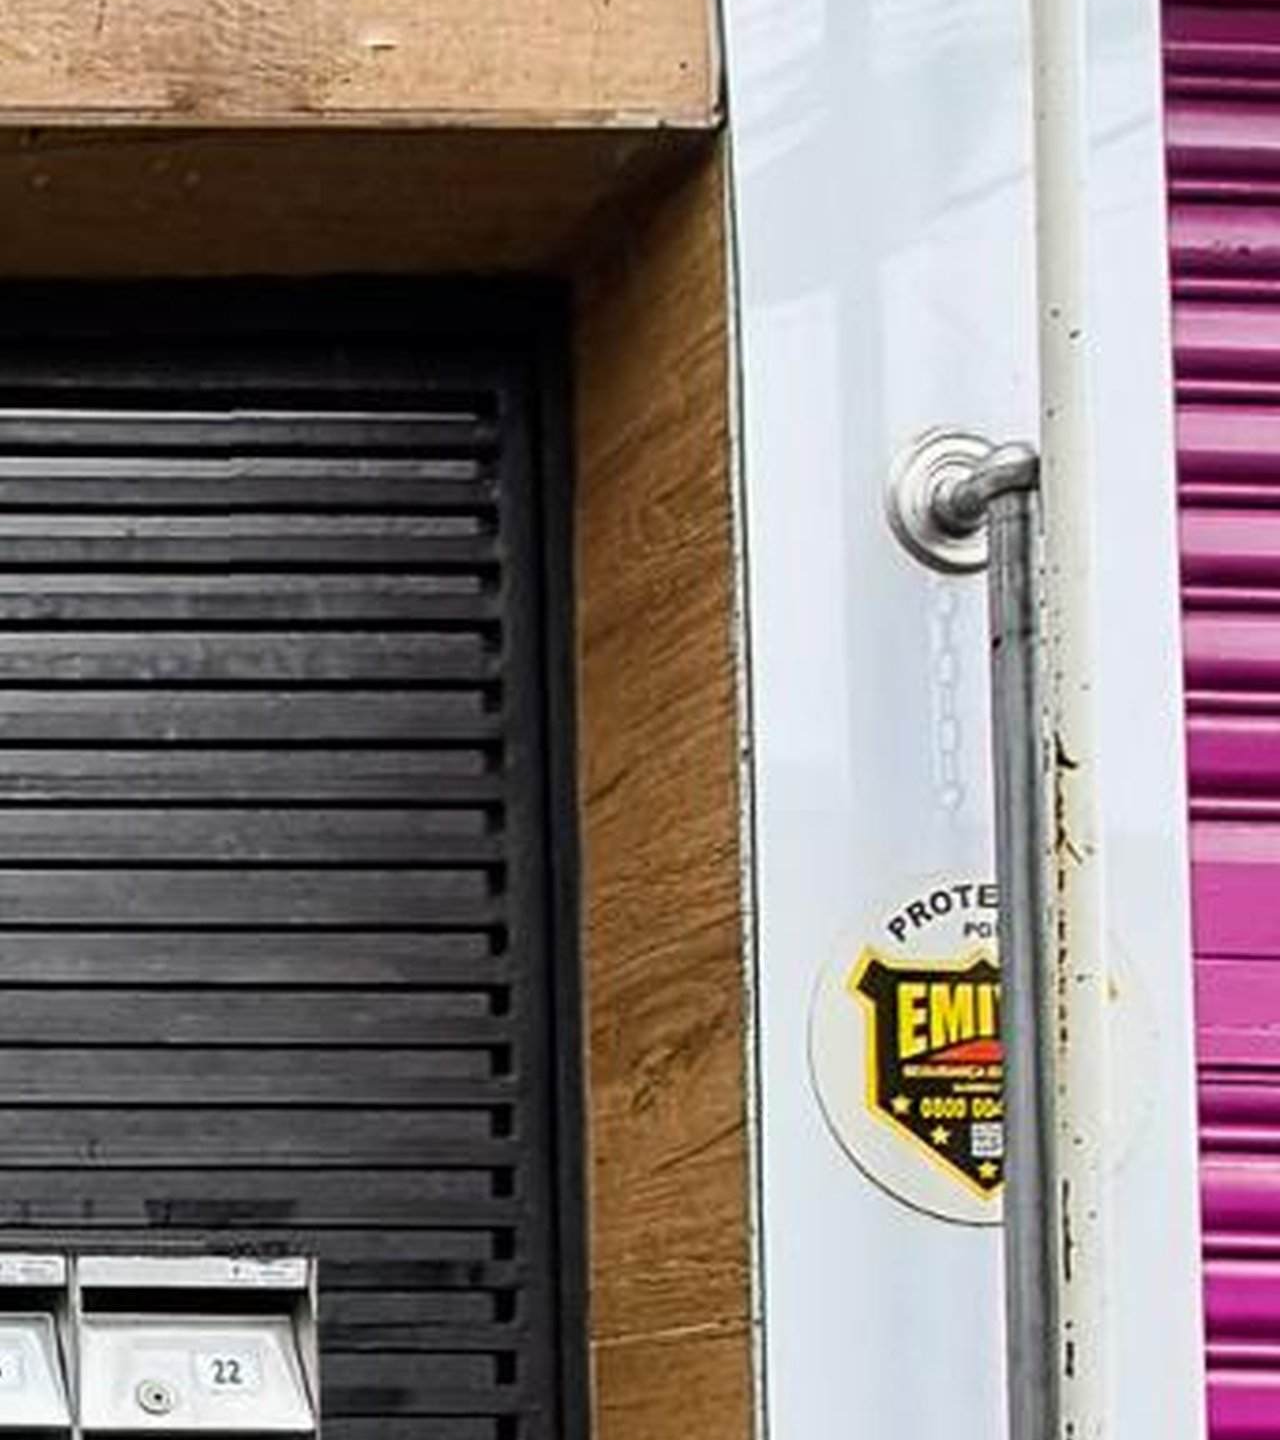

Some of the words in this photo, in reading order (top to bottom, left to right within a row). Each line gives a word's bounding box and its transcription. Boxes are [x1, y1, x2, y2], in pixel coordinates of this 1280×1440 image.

[887, 883, 1001, 944] PROTE
[963, 921, 1001, 939] PO
[896, 981, 1003, 1059] EMI
[212, 1358, 243, 1385] 22
